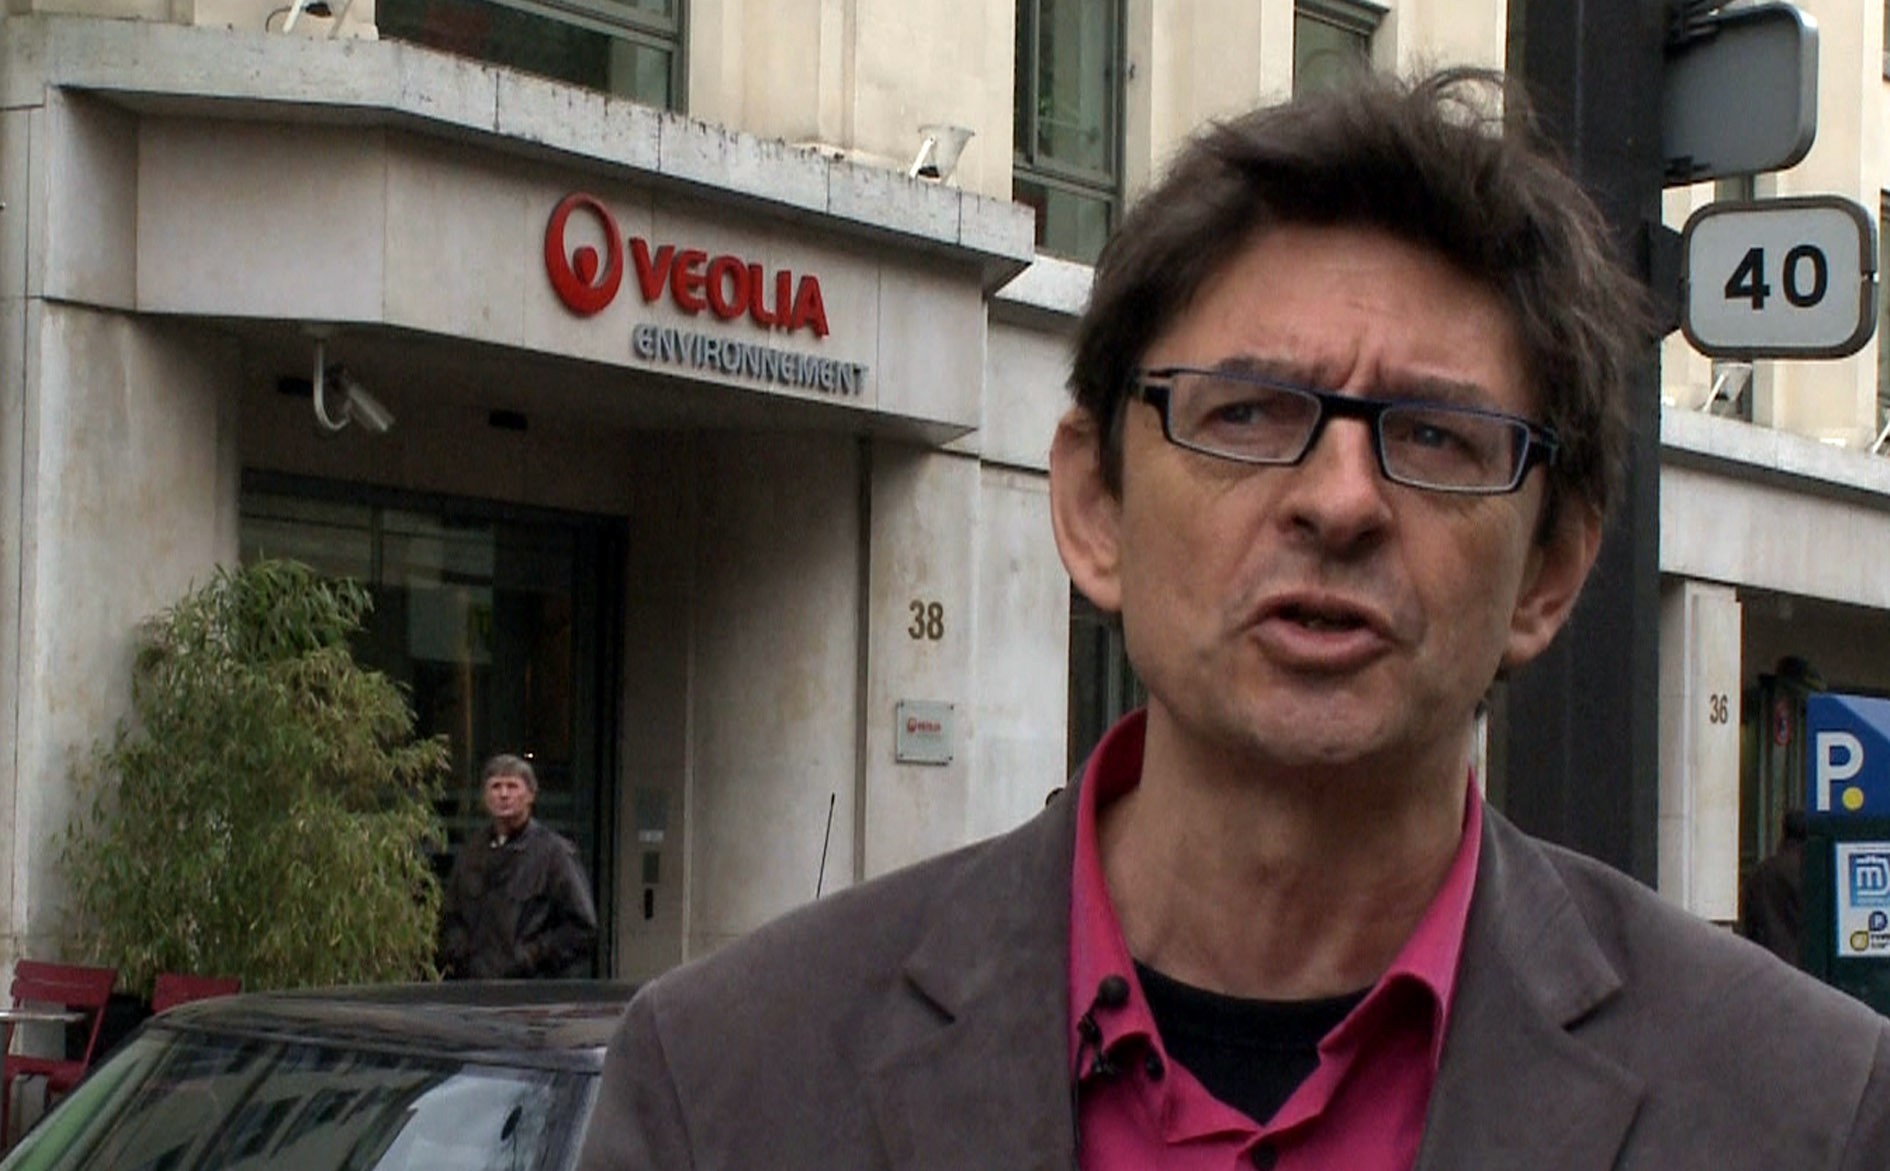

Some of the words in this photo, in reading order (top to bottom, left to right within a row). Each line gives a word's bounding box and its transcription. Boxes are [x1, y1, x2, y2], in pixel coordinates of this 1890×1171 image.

[629, 237, 830, 338] VEOLIA
[1724, 244, 1828, 311] 40
[633, 323, 868, 395] ENVIRONNEMENT
[908, 599, 944, 640] 38
[1709, 694, 1728, 724] 36
